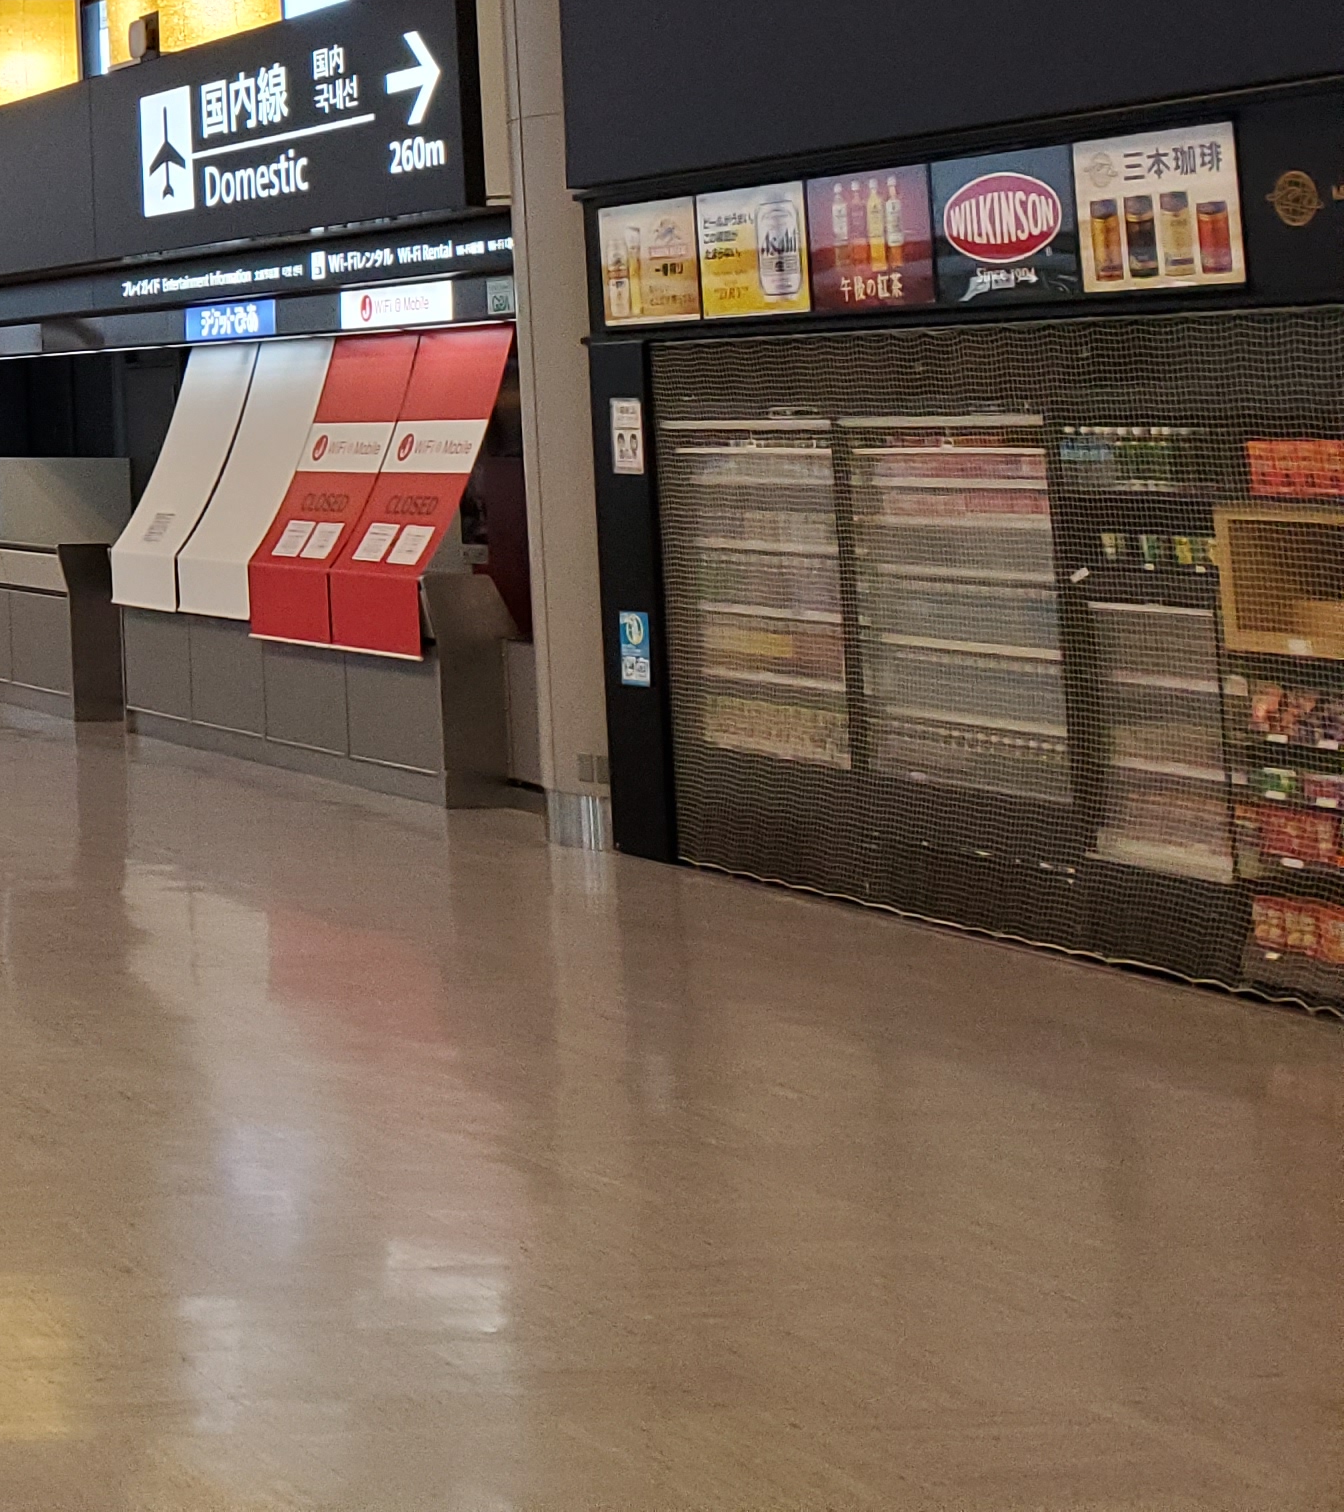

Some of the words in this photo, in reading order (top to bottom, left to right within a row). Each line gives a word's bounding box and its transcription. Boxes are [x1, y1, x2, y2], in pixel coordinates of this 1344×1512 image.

[313, 44, 345, 81] 国内
[200, 62, 289, 139] 国内線
[314, 74, 359, 114] 국내선
[389, 136, 446, 175] 260m
[1123, 141, 1223, 181] 三本珈琲
[204, 148, 309, 207] Domestic
[950, 191, 1055, 245] WILKINSON
[328, 247, 394, 274] Wi-Fiレンタル
[397, 246, 422, 265] Wi-Fi
[422, 239, 453, 262] Rental
[403, 295, 430, 311] Mobile
[840, 273, 904, 303] 午後の紅茶
[300, 493, 350, 513] CLOSED
[385, 495, 439, 516] CLOSED
